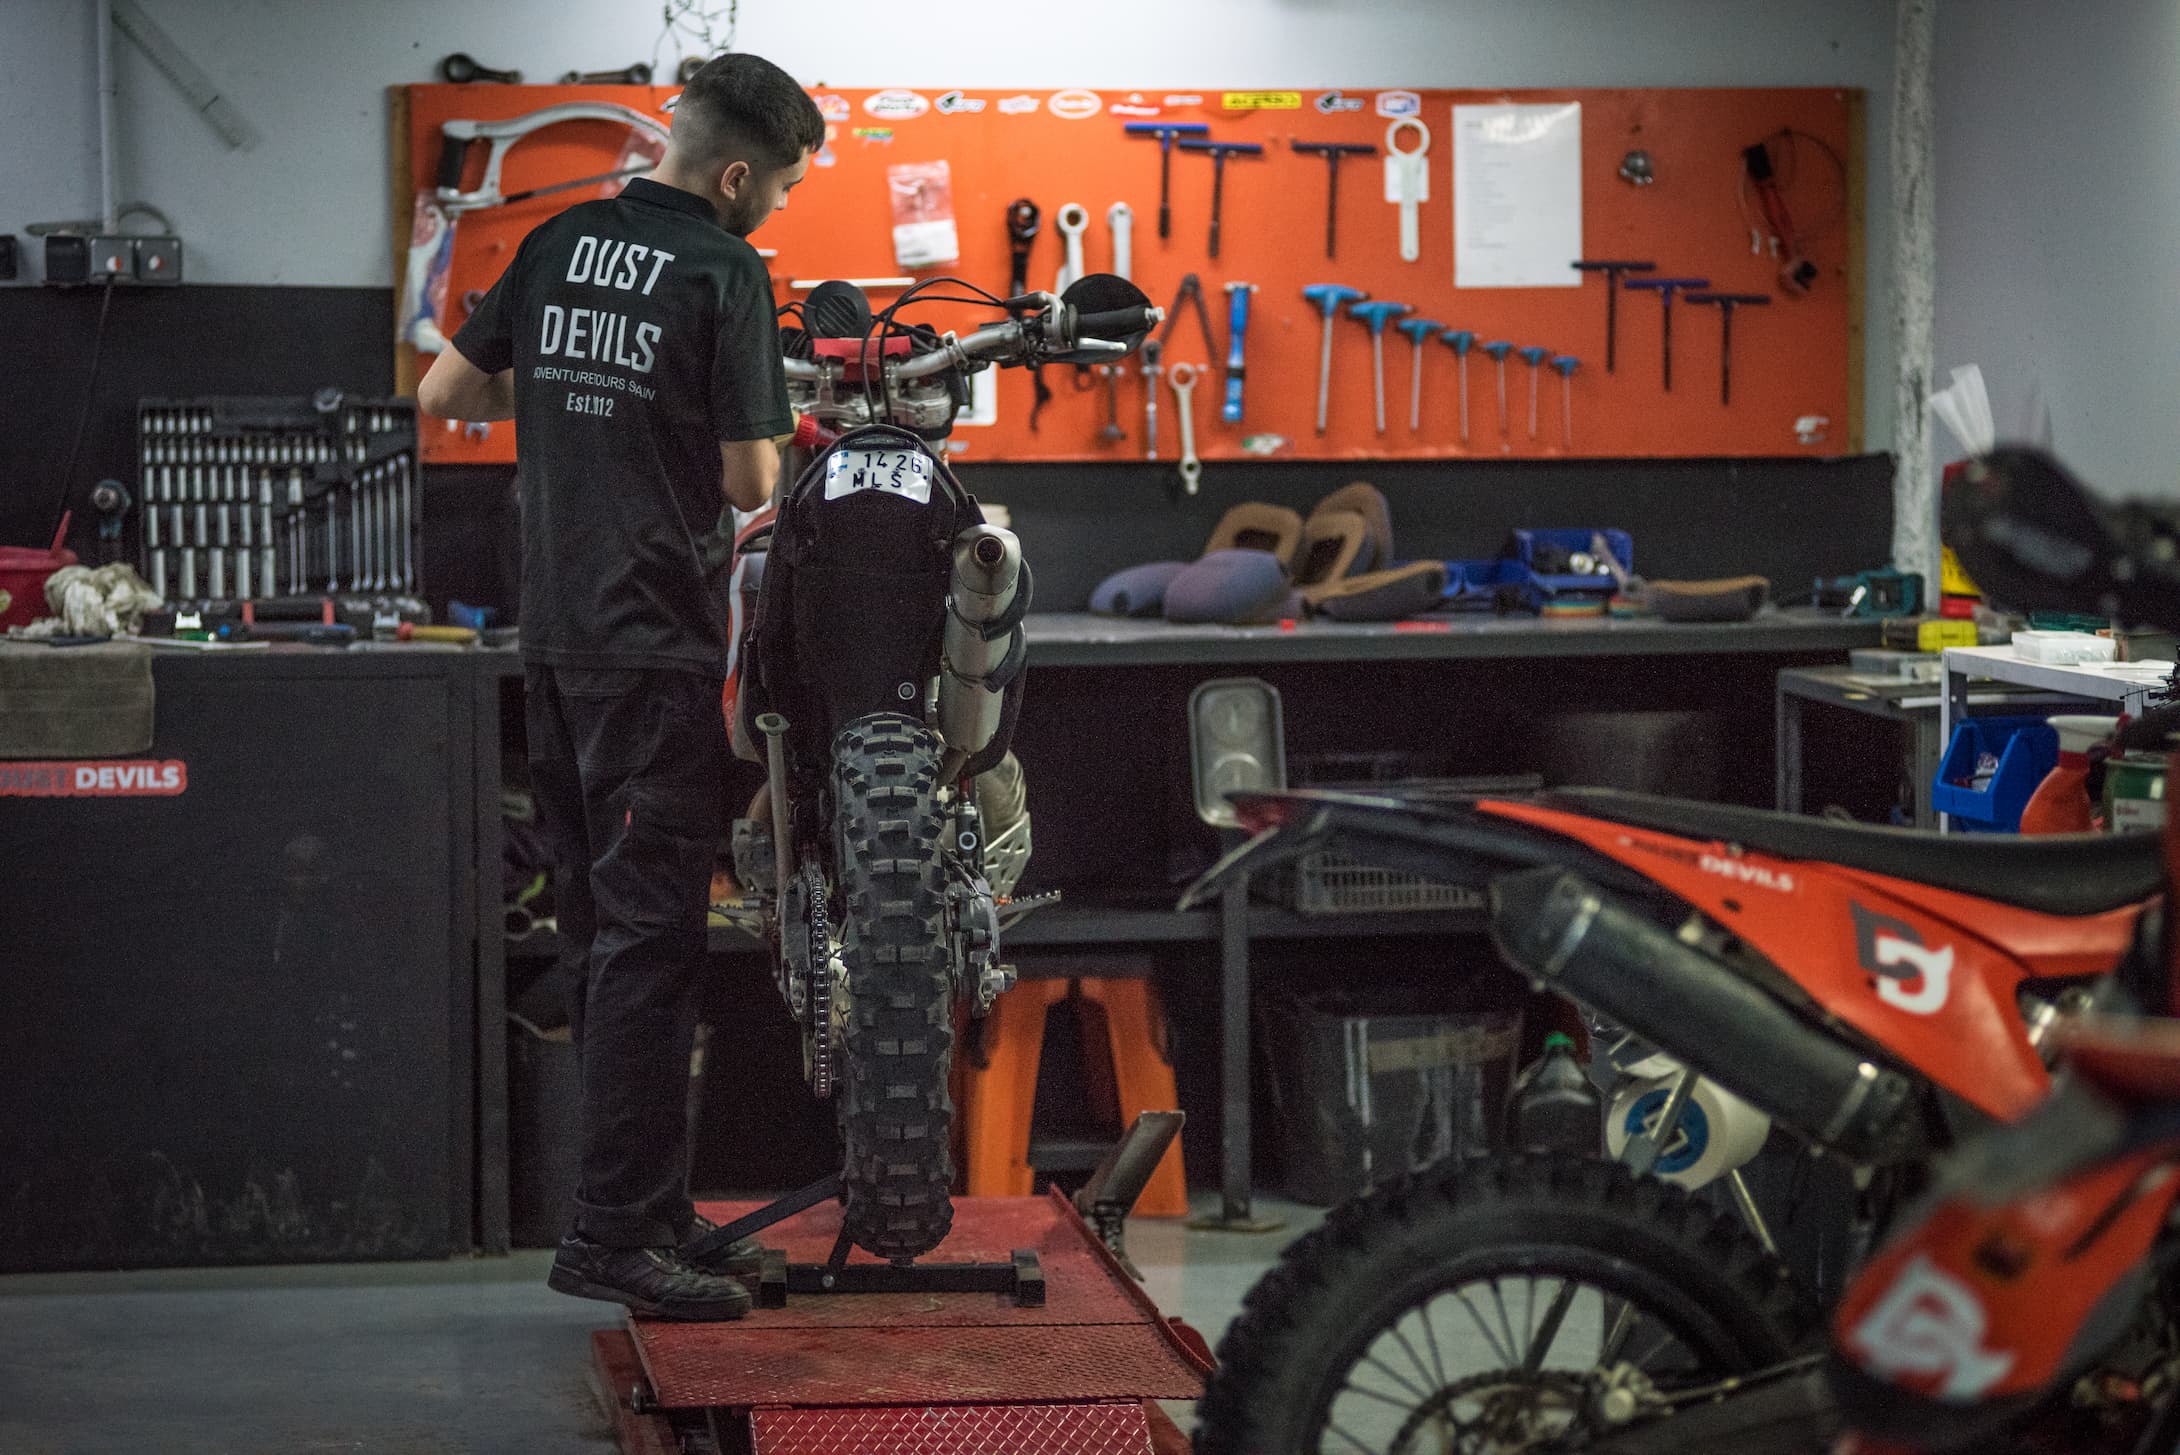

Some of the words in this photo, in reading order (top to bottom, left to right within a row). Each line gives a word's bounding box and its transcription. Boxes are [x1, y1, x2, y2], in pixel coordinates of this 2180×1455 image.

[566, 235, 676, 296] DUST
[540, 304, 663, 374] DEVILS
[593, 373, 626, 391] OURS
[852, 471, 903, 489] MLS
[75, 766, 180, 790] DEVILS
[1700, 853, 1794, 892] DEVILS
